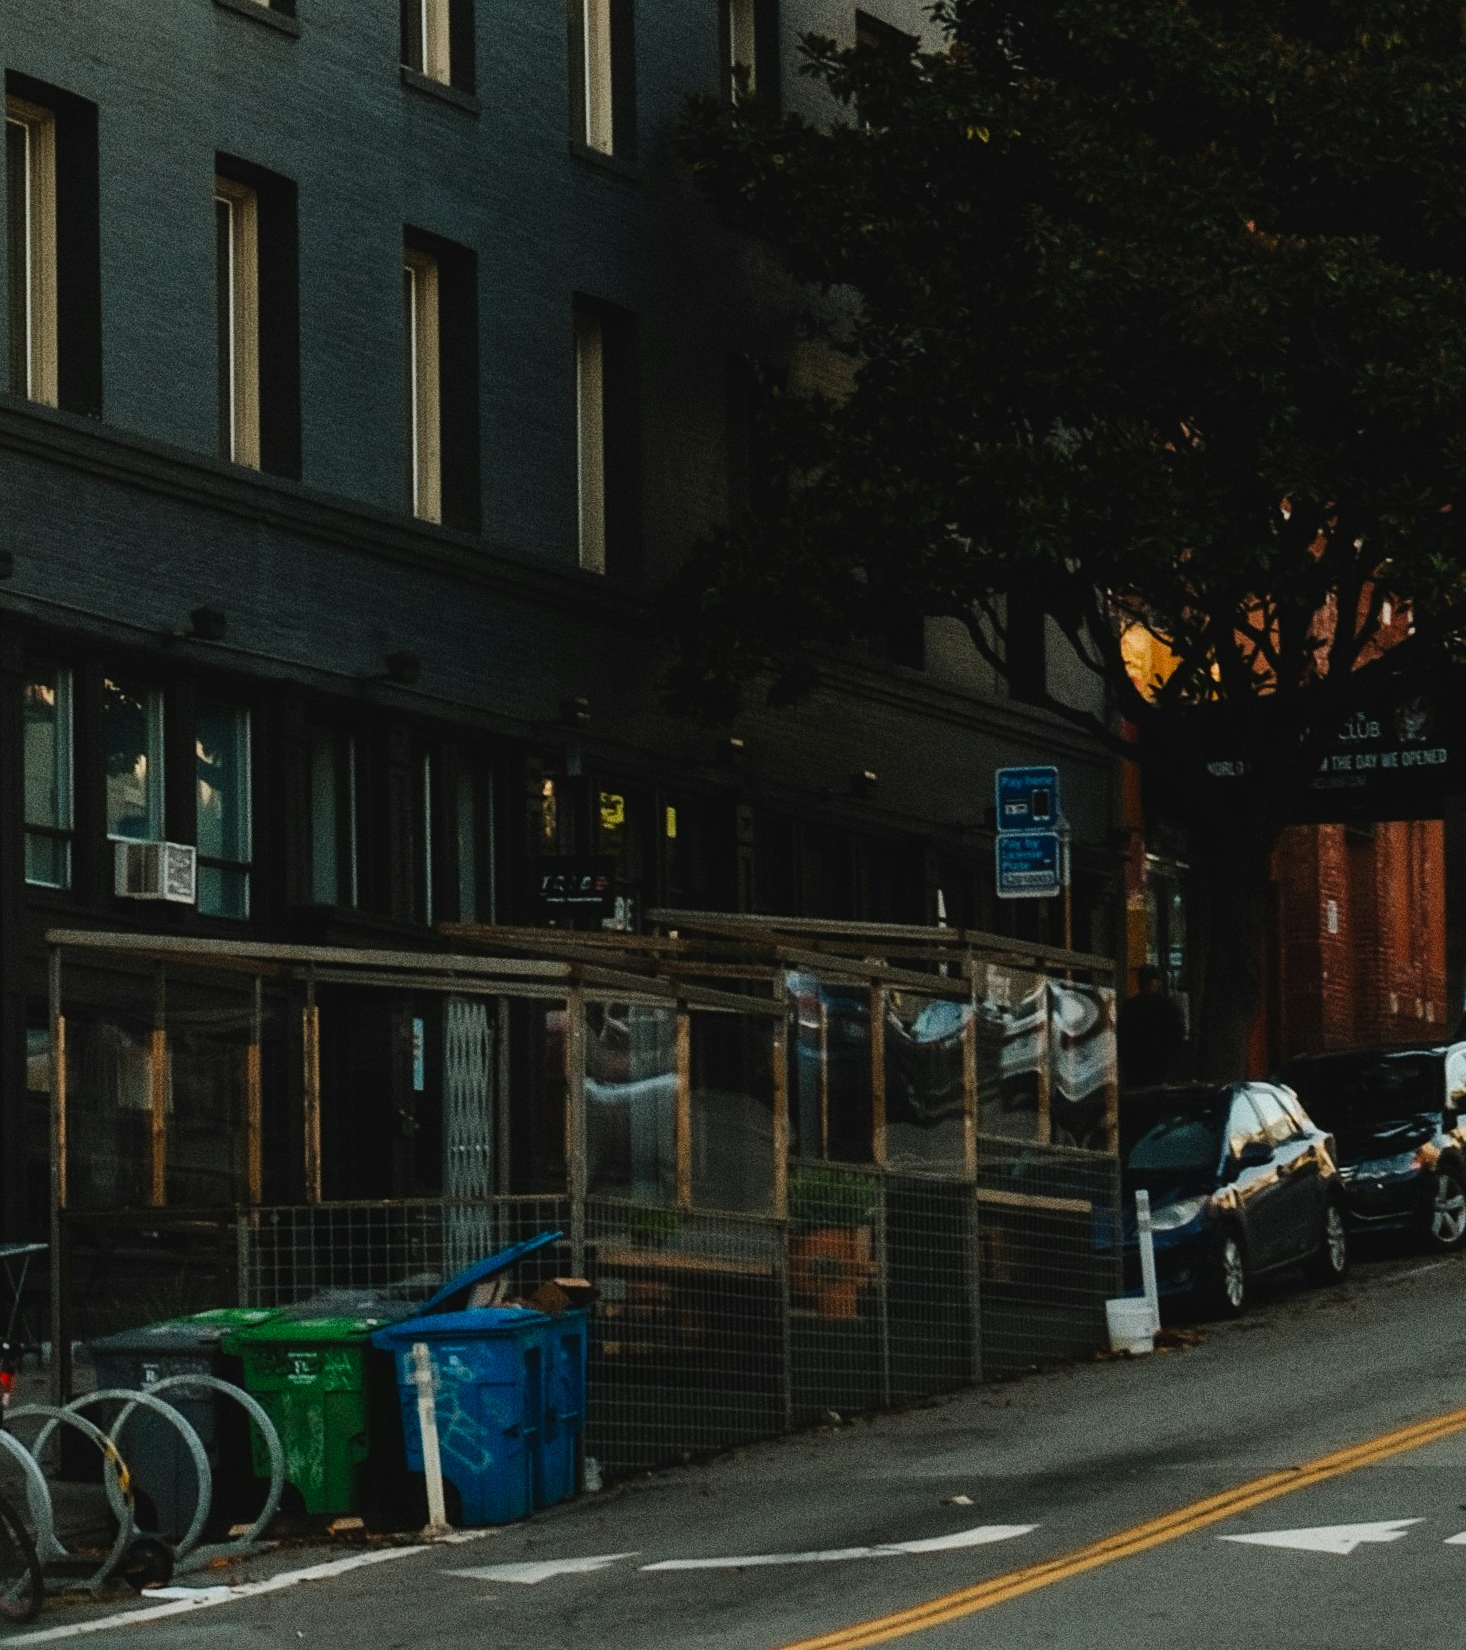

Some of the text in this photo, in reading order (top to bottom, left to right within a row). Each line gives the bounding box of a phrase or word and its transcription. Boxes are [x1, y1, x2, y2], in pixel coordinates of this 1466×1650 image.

[1331, 754, 1353, 772] THE
[1355, 753, 1378, 771] DAY
[1401, 747, 1449, 767] OPENED
